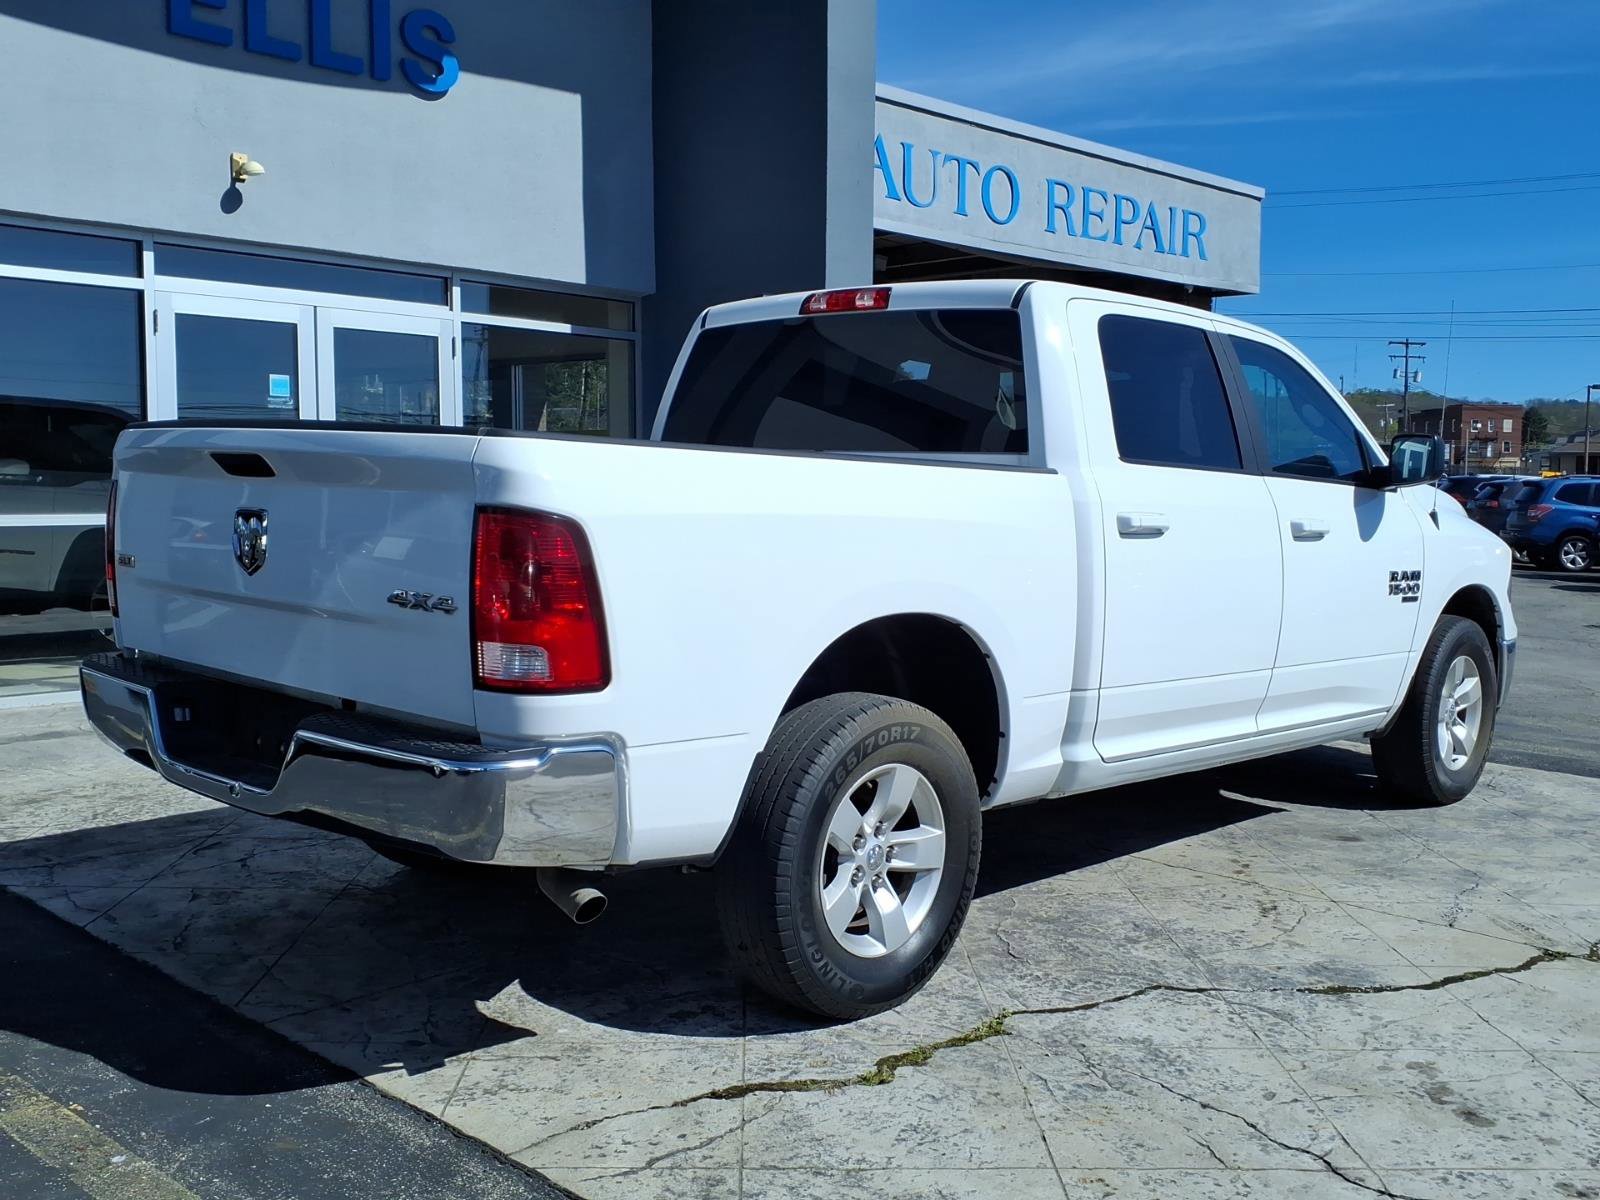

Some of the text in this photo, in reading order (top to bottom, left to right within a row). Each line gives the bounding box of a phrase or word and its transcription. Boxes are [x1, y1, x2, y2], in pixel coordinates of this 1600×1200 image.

[873, 133, 1208, 261] AUTO REPAIR
[1388, 583, 1420, 596] 1500
[1389, 570, 1421, 582] RAM
[825, 724, 922, 804] 265/70R17
